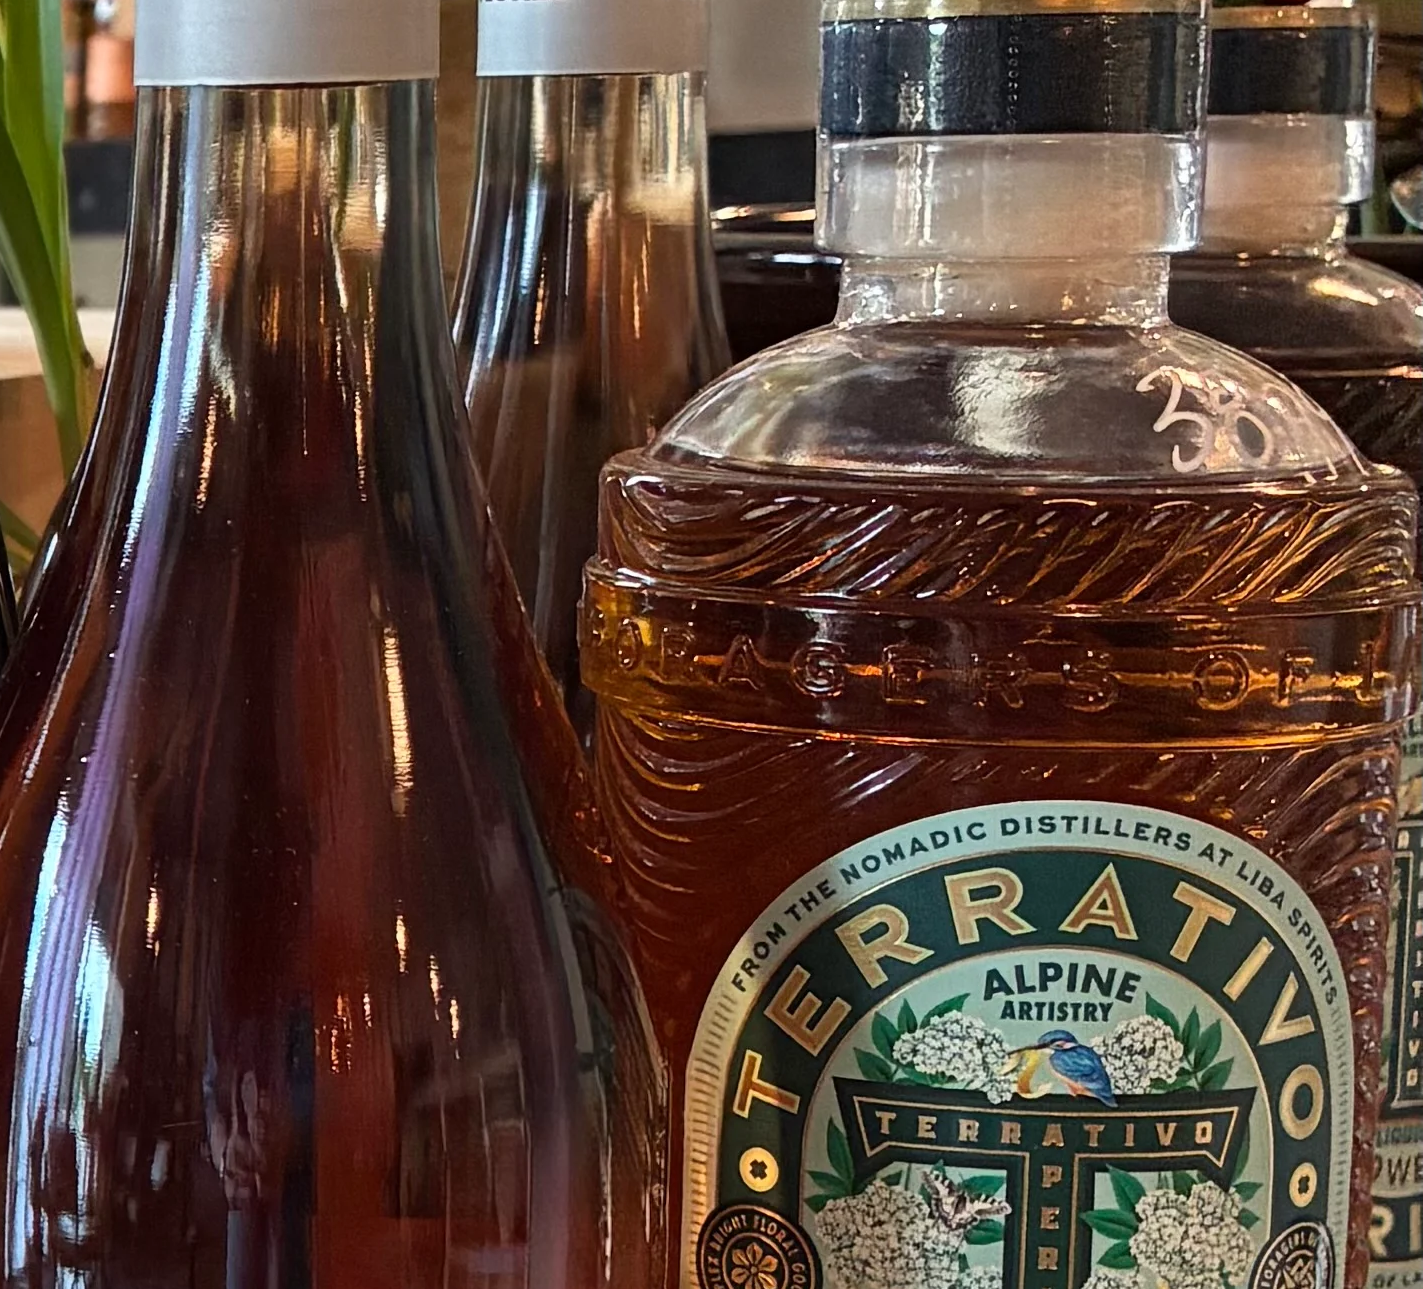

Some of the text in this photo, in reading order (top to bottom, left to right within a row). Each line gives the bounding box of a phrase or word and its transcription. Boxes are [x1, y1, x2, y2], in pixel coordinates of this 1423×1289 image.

[731, 815, 1339, 1009] FROM THE NOMADIC DISTILLERS AT LIBA SPIRITS
[732, 861, 1324, 1141] TERRATIVO
[983, 960, 1143, 1005] ALPINE
[1000, 999, 1114, 1023] ARTISTRY
[875, 1111, 1214, 1147] TERRATIVO
